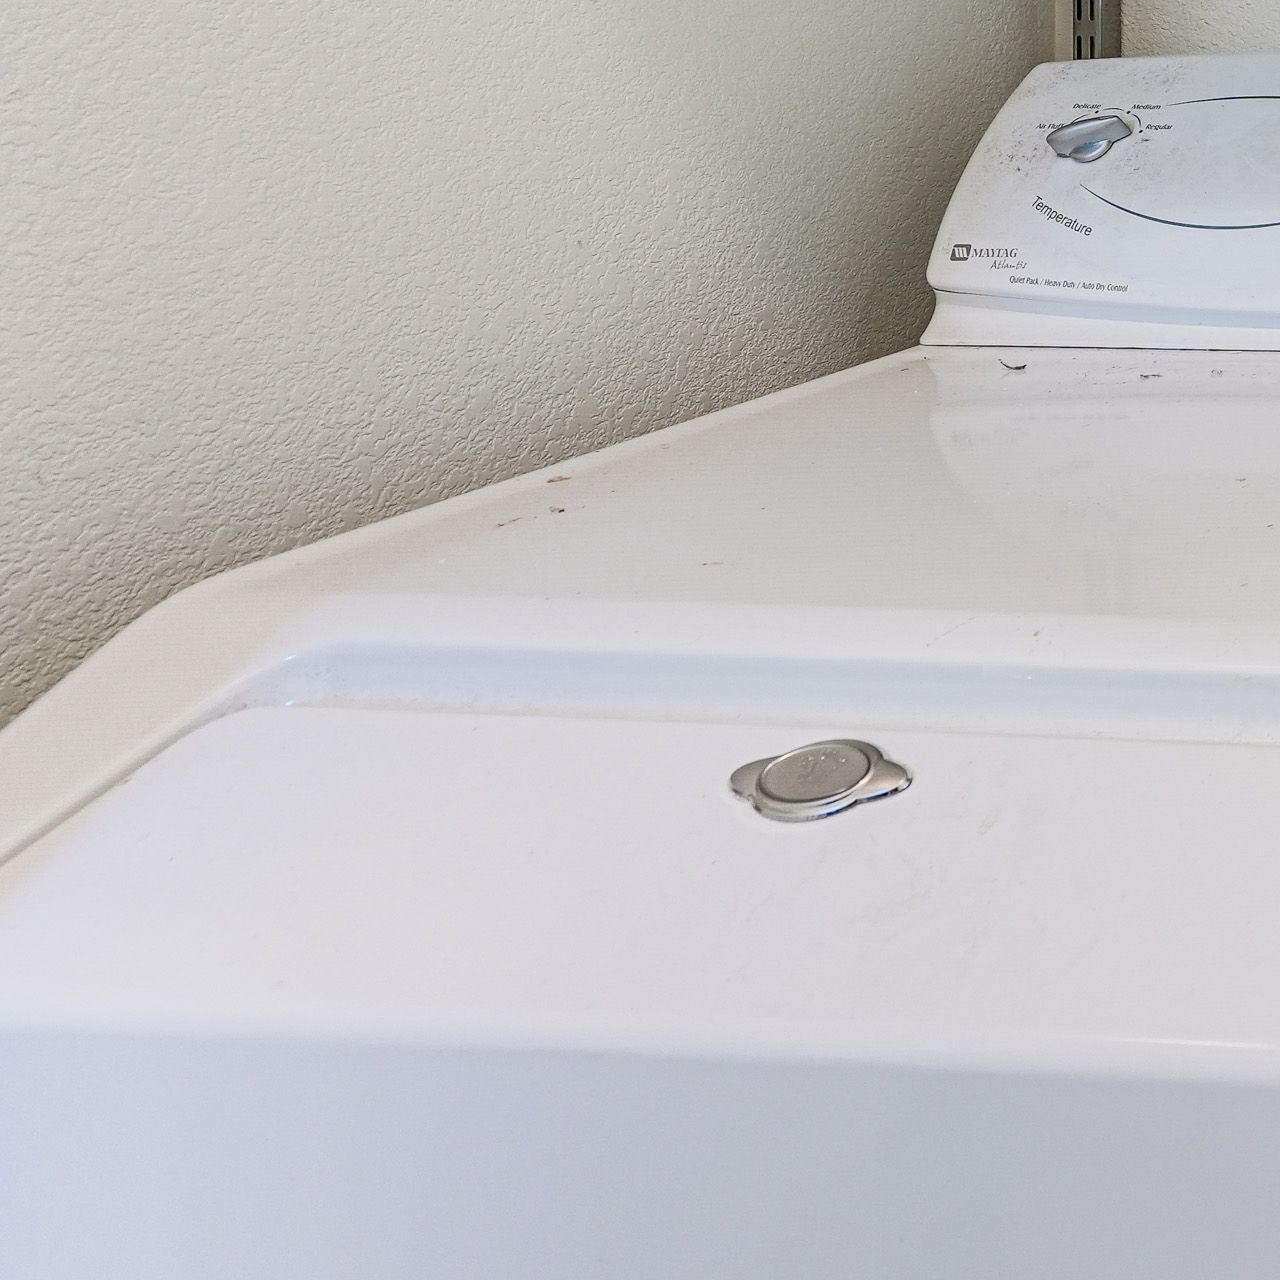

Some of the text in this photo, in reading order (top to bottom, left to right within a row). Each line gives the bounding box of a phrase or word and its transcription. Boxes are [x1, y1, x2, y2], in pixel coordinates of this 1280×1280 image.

[1145, 123, 1173, 131] Regular
[1031, 195, 1093, 237] Temperature
[971, 247, 1019, 258] MAYTAG
[990, 260, 1028, 270] Atlantis
[1009, 275, 1129, 293] Quiet Pack Heavy Duty Auto Dry Control
